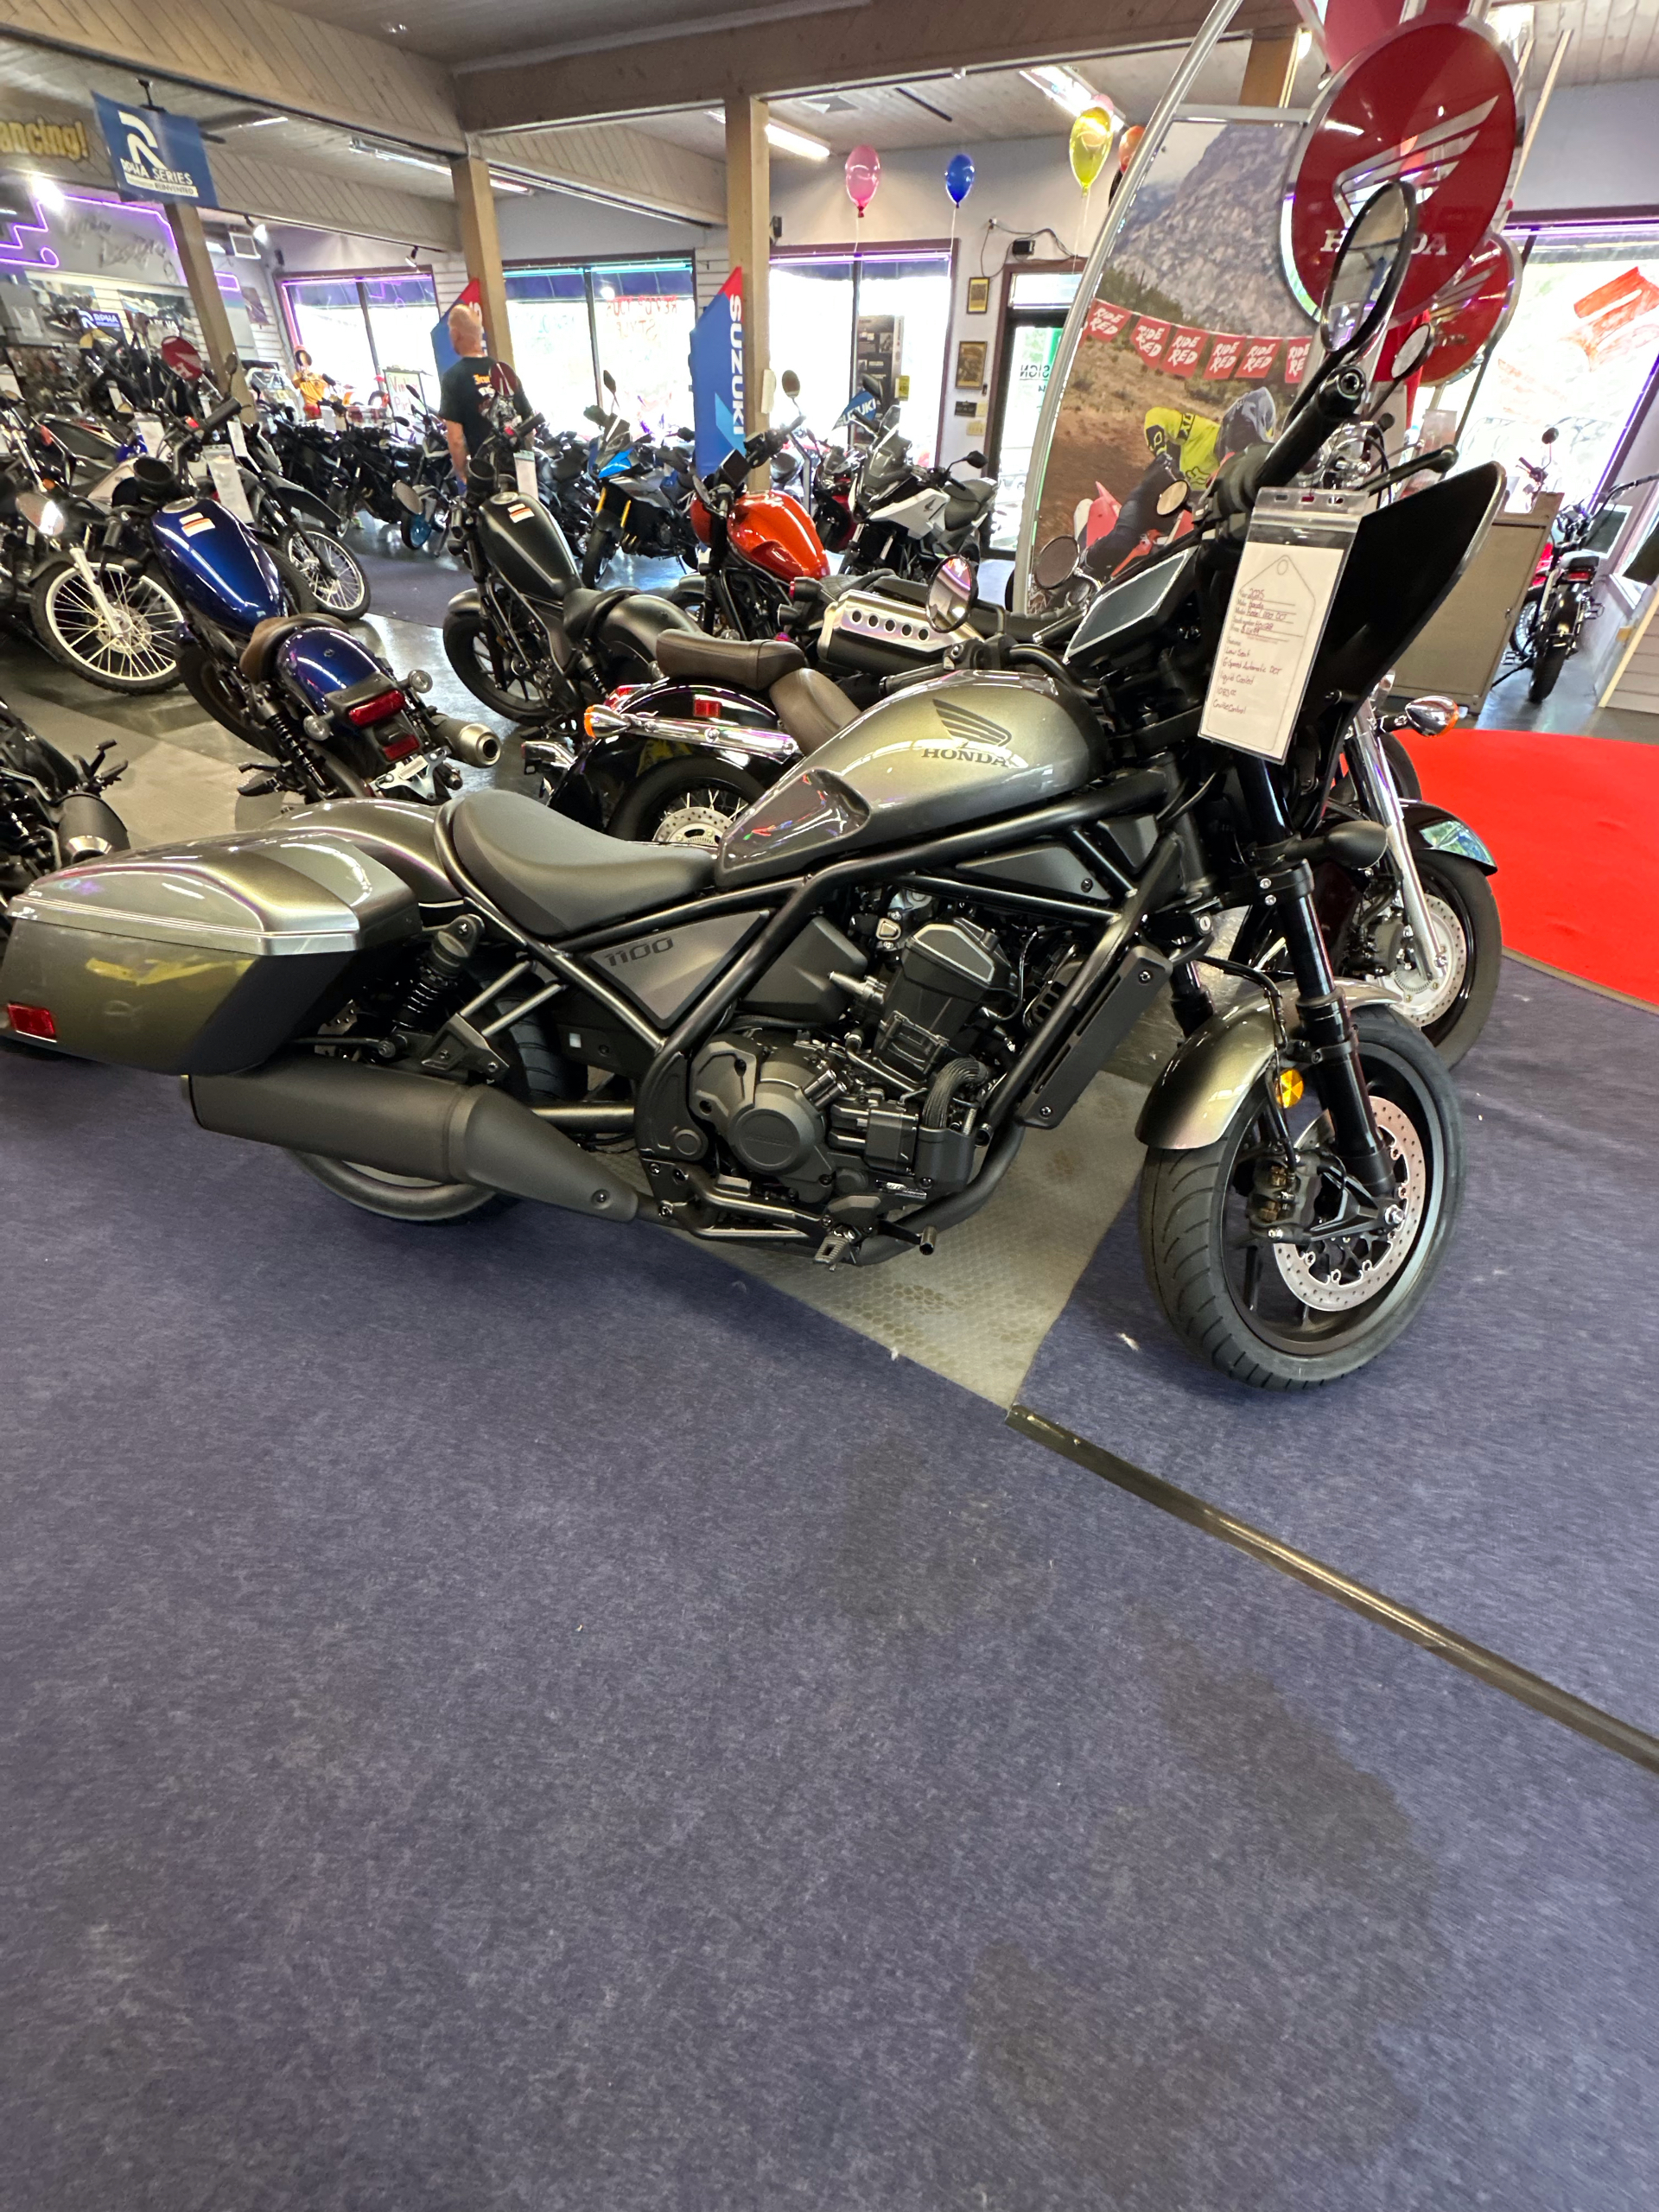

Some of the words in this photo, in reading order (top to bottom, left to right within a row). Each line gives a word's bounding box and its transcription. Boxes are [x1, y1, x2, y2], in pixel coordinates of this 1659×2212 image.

[152, 168, 194, 185] SERIES
[1320, 229, 1447, 256] HDA
[1093, 308, 1124, 323] RIDE
[1090, 318, 1118, 334] RED
[1138, 325, 1165, 340] RIDE
[1135, 334, 1162, 357] RED
[1172, 335, 1201, 349] RIDE
[1212, 341, 1241, 356] RIDE
[1247, 343, 1276, 358] RIDE
[730, 294, 745, 435] SUZUKI
[1167, 349, 1198, 367] RED
[1209, 356, 1236, 373] RED
[1243, 356, 1273, 372] RED
[1288, 357, 1306, 378] RE
[921, 748, 1009, 767] HONDA
[605, 937, 673, 966] 1100
